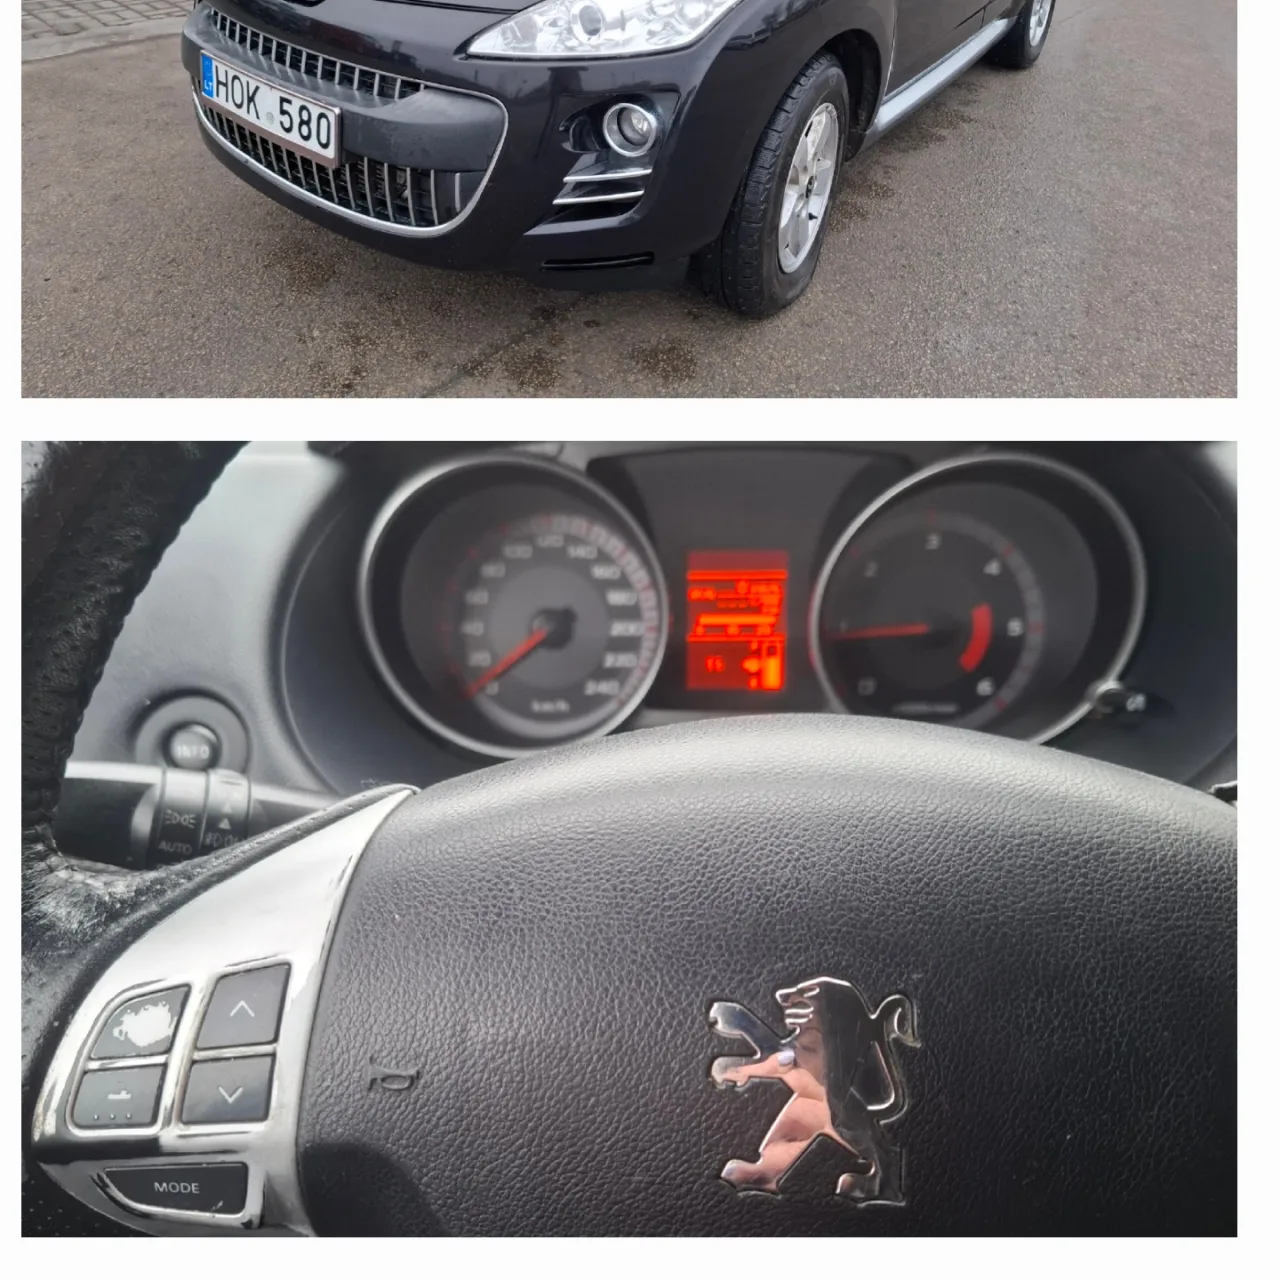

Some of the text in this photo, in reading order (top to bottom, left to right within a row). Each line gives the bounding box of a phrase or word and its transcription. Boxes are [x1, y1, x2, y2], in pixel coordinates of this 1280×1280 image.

[204, 79, 213, 91] LT
[215, 64, 331, 150] HOK 580
[158, 841, 193, 855] AUTO
[154, 1182, 200, 1194] MODE
